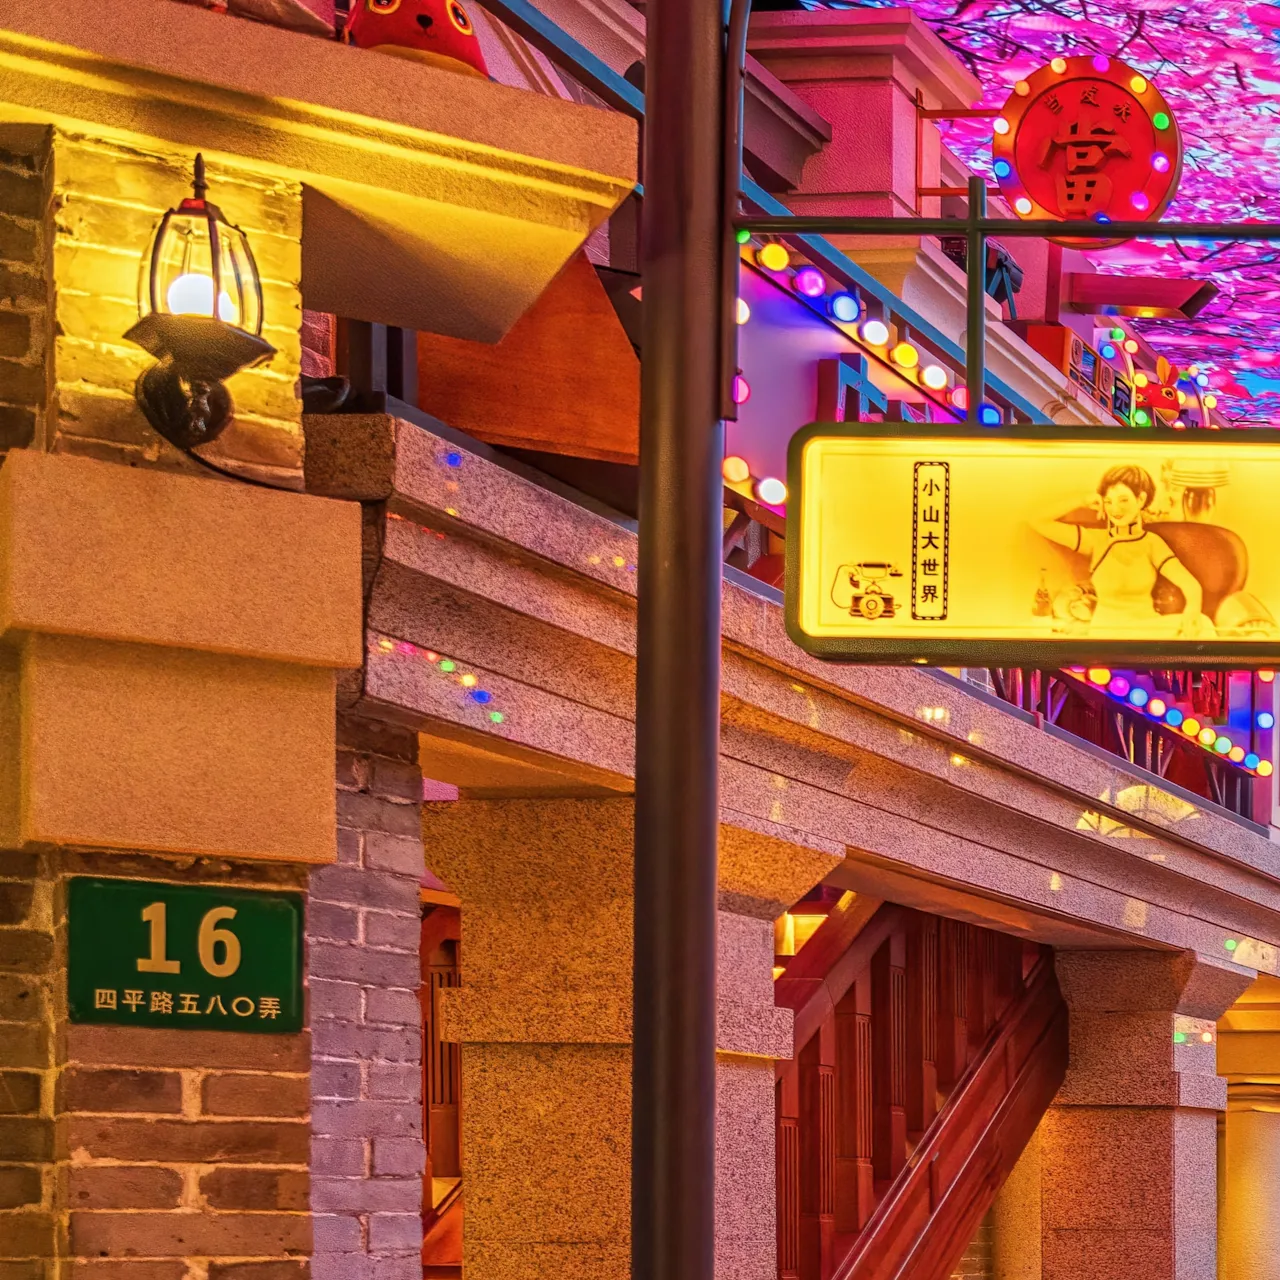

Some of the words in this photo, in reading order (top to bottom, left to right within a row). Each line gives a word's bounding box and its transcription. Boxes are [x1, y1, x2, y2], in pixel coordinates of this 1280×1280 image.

[920, 476, 942, 606] 小山大世界
[136, 901, 242, 979] 16
